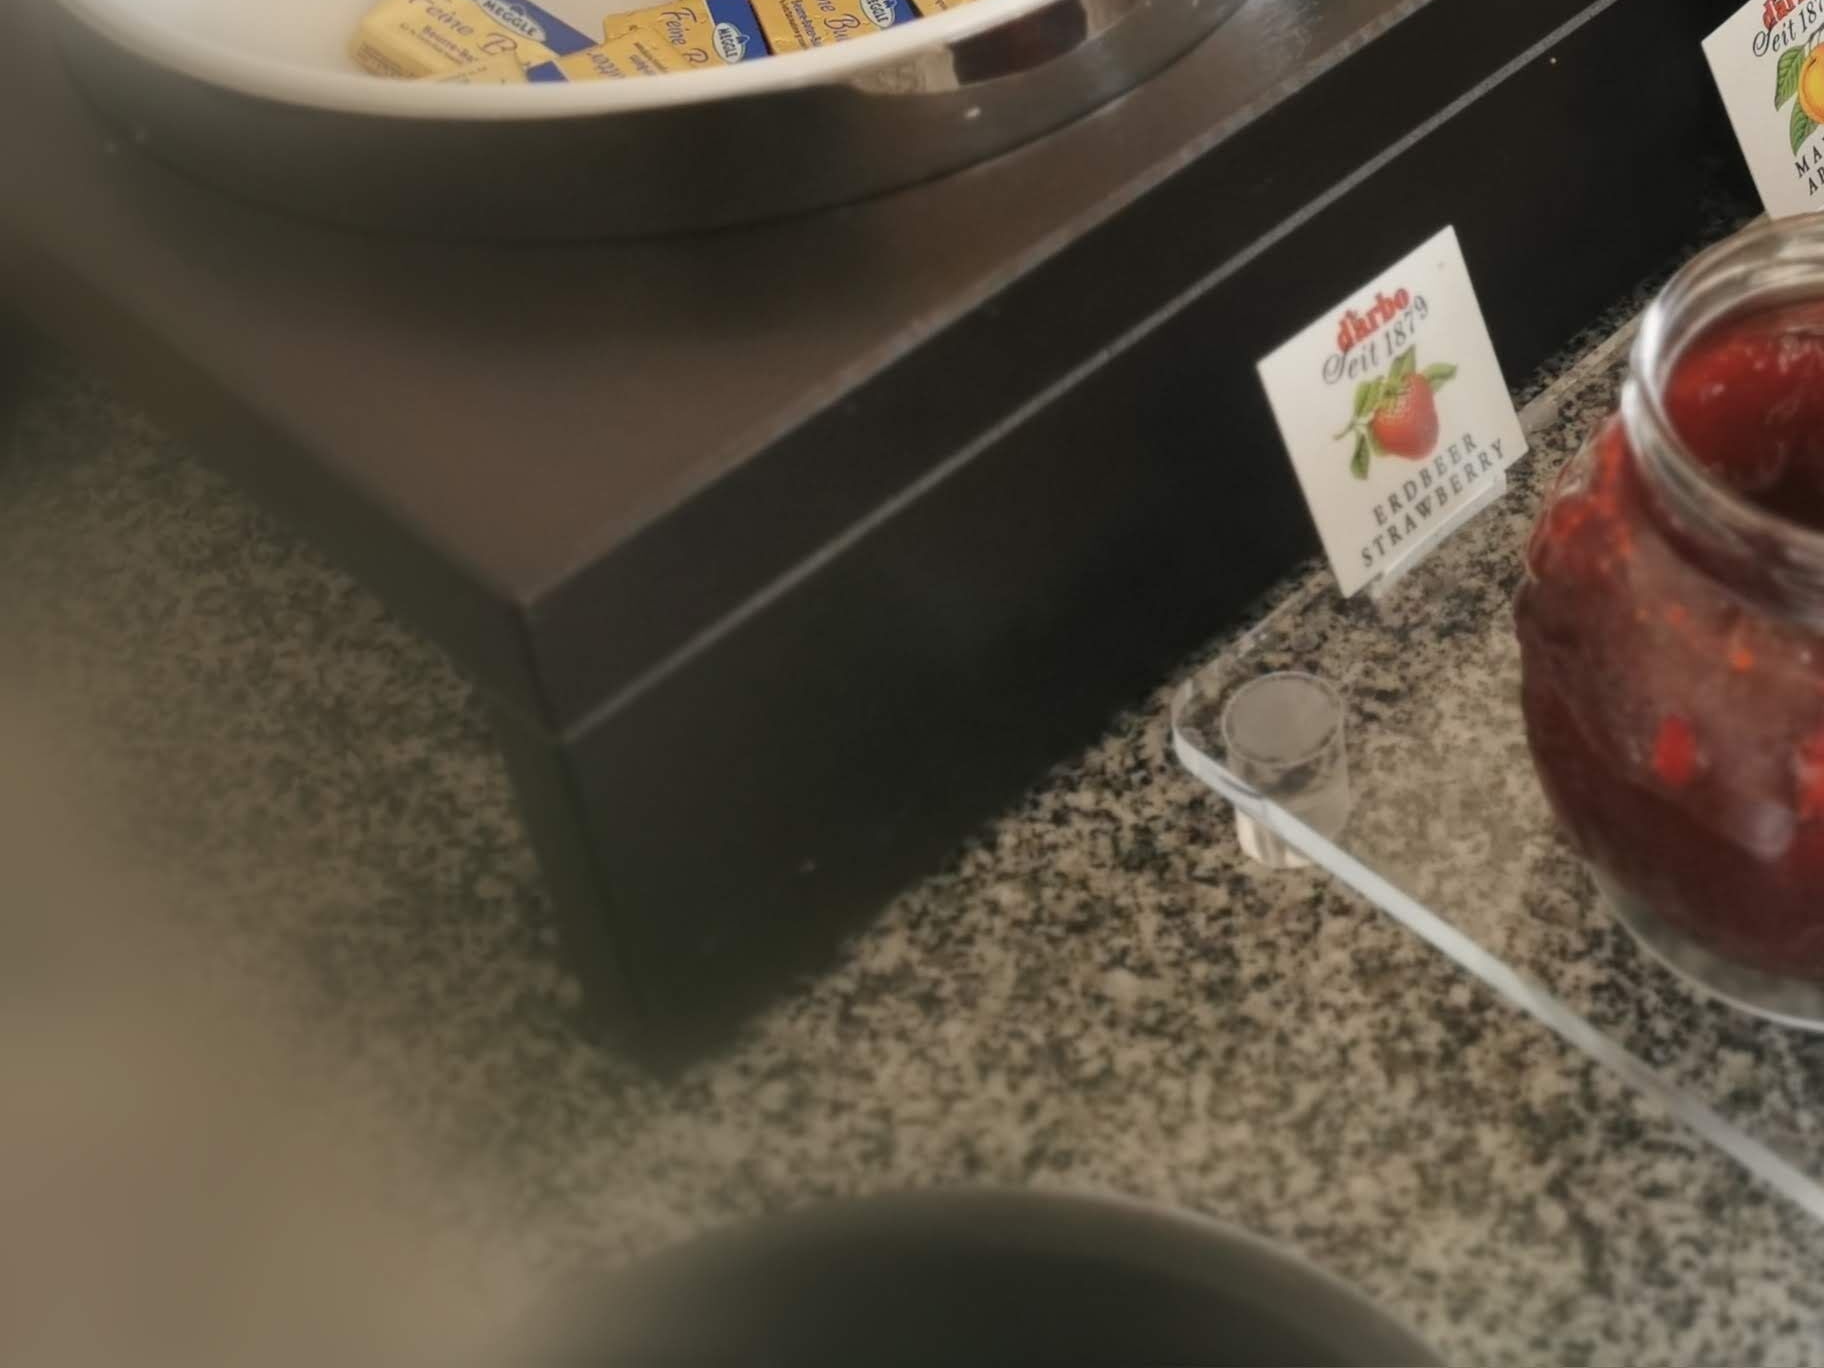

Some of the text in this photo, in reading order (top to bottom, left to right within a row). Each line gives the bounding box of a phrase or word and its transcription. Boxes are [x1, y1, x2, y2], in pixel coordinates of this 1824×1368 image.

[483, 0, 537, 36] MEGGLE
[660, 6, 697, 46] Feine
[718, 28, 738, 59] MEGGLE
[1752, 22, 1797, 58] Seit
[1322, 294, 1430, 385] Seit 1879
[1371, 433, 1478, 527] ERDBEER
[1359, 437, 1506, 568] STRAWBERRY
